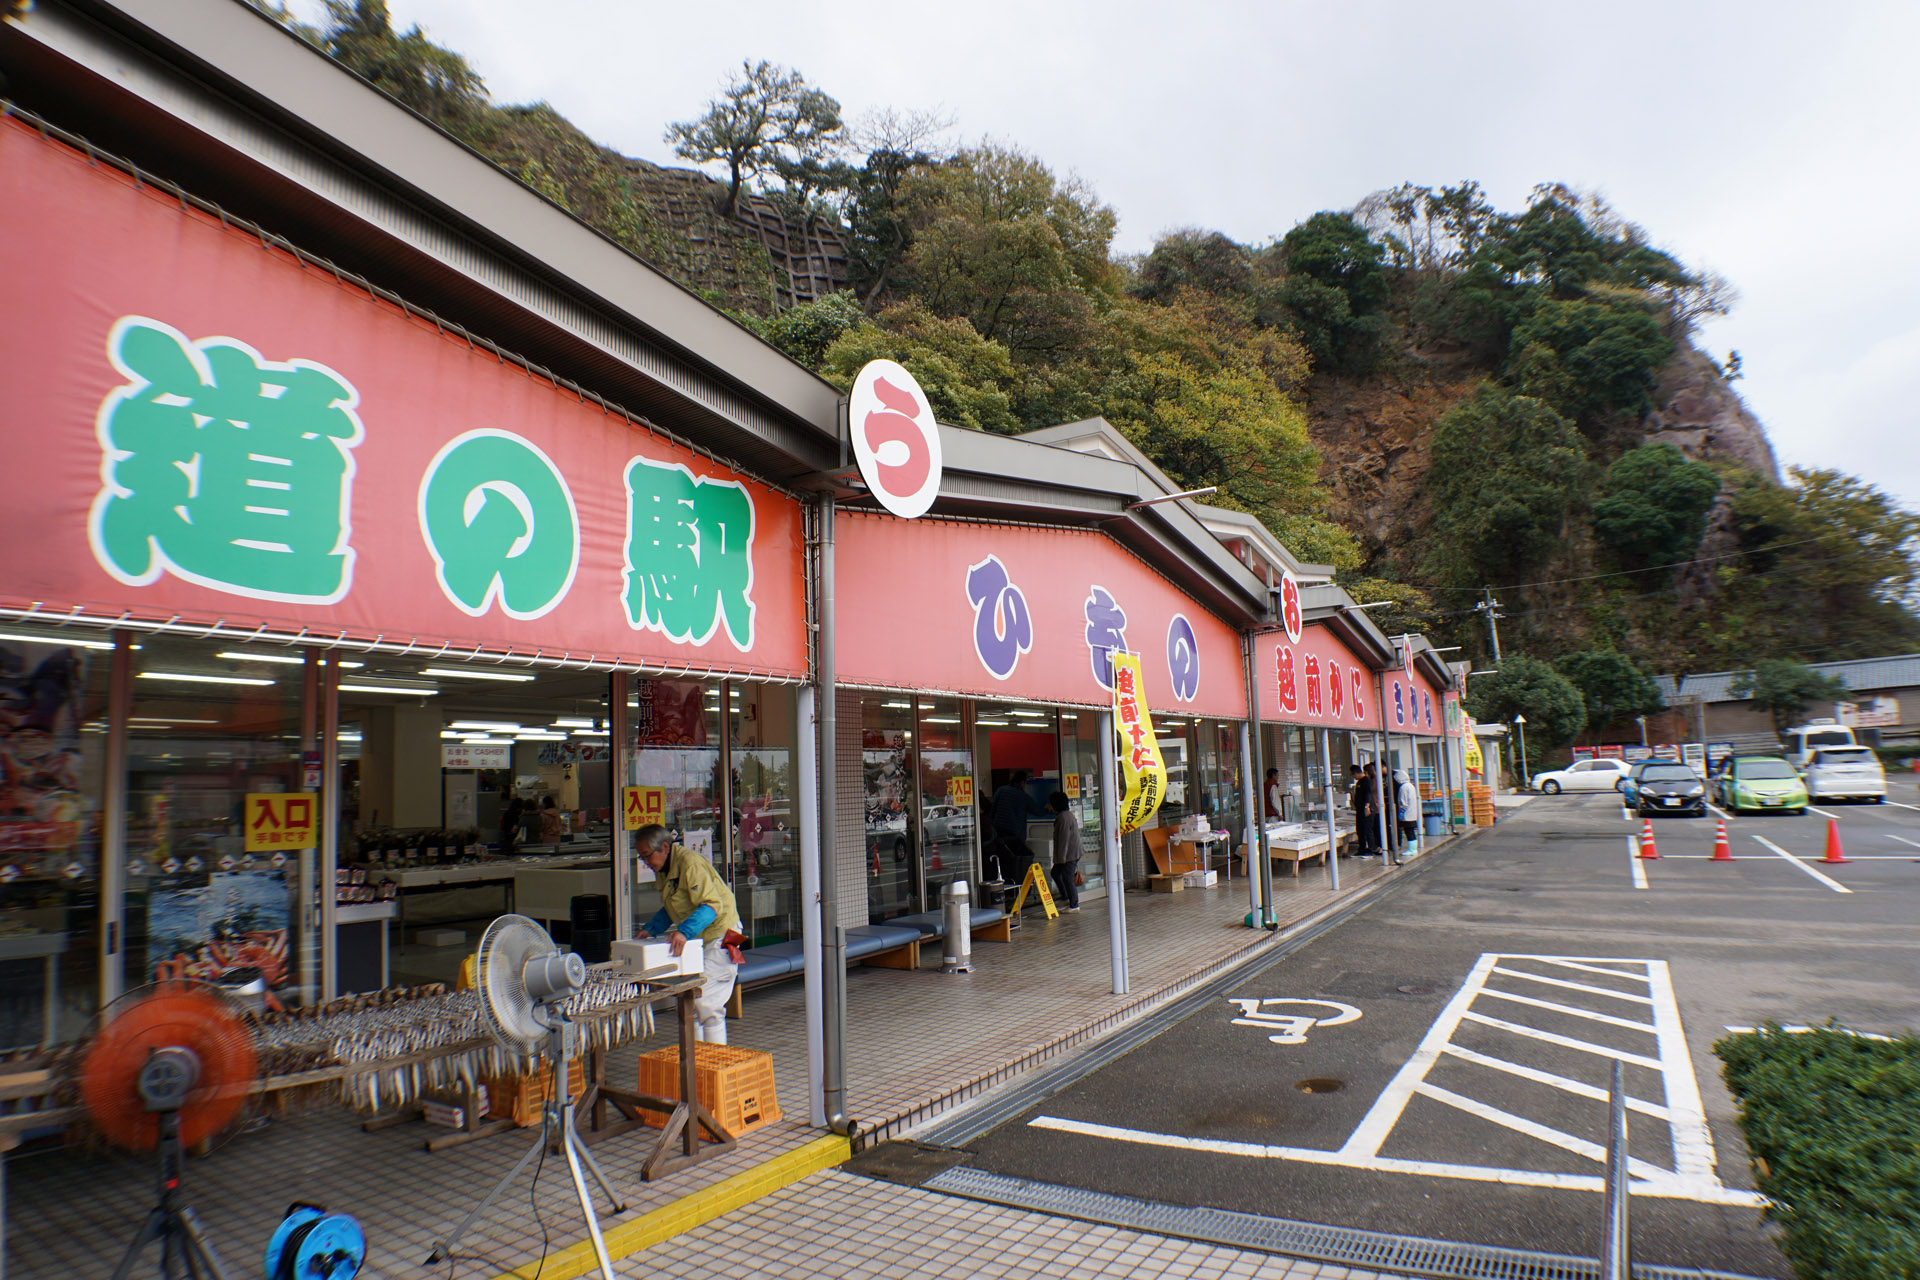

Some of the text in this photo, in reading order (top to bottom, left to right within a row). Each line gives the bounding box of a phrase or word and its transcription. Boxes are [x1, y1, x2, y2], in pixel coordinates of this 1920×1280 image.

[863, 376, 931, 497] う
[88, 314, 756, 652] 道の駅
[1283, 578, 1300, 636] お
[965, 554, 1199, 702] ひもの
[1275, 645, 1365, 721] 越前かに
[1393, 680, 1432, 730] さかな
[474, 748, 505, 756] CASHIER
[955, 779, 972, 796] 入口
[1066, 775, 1079, 789] 入口
[251, 799, 311, 830] 入口
[628, 791, 661, 814] 入口
[629, 815, 661, 825] 手動です
[254, 831, 309, 844] 手動です
